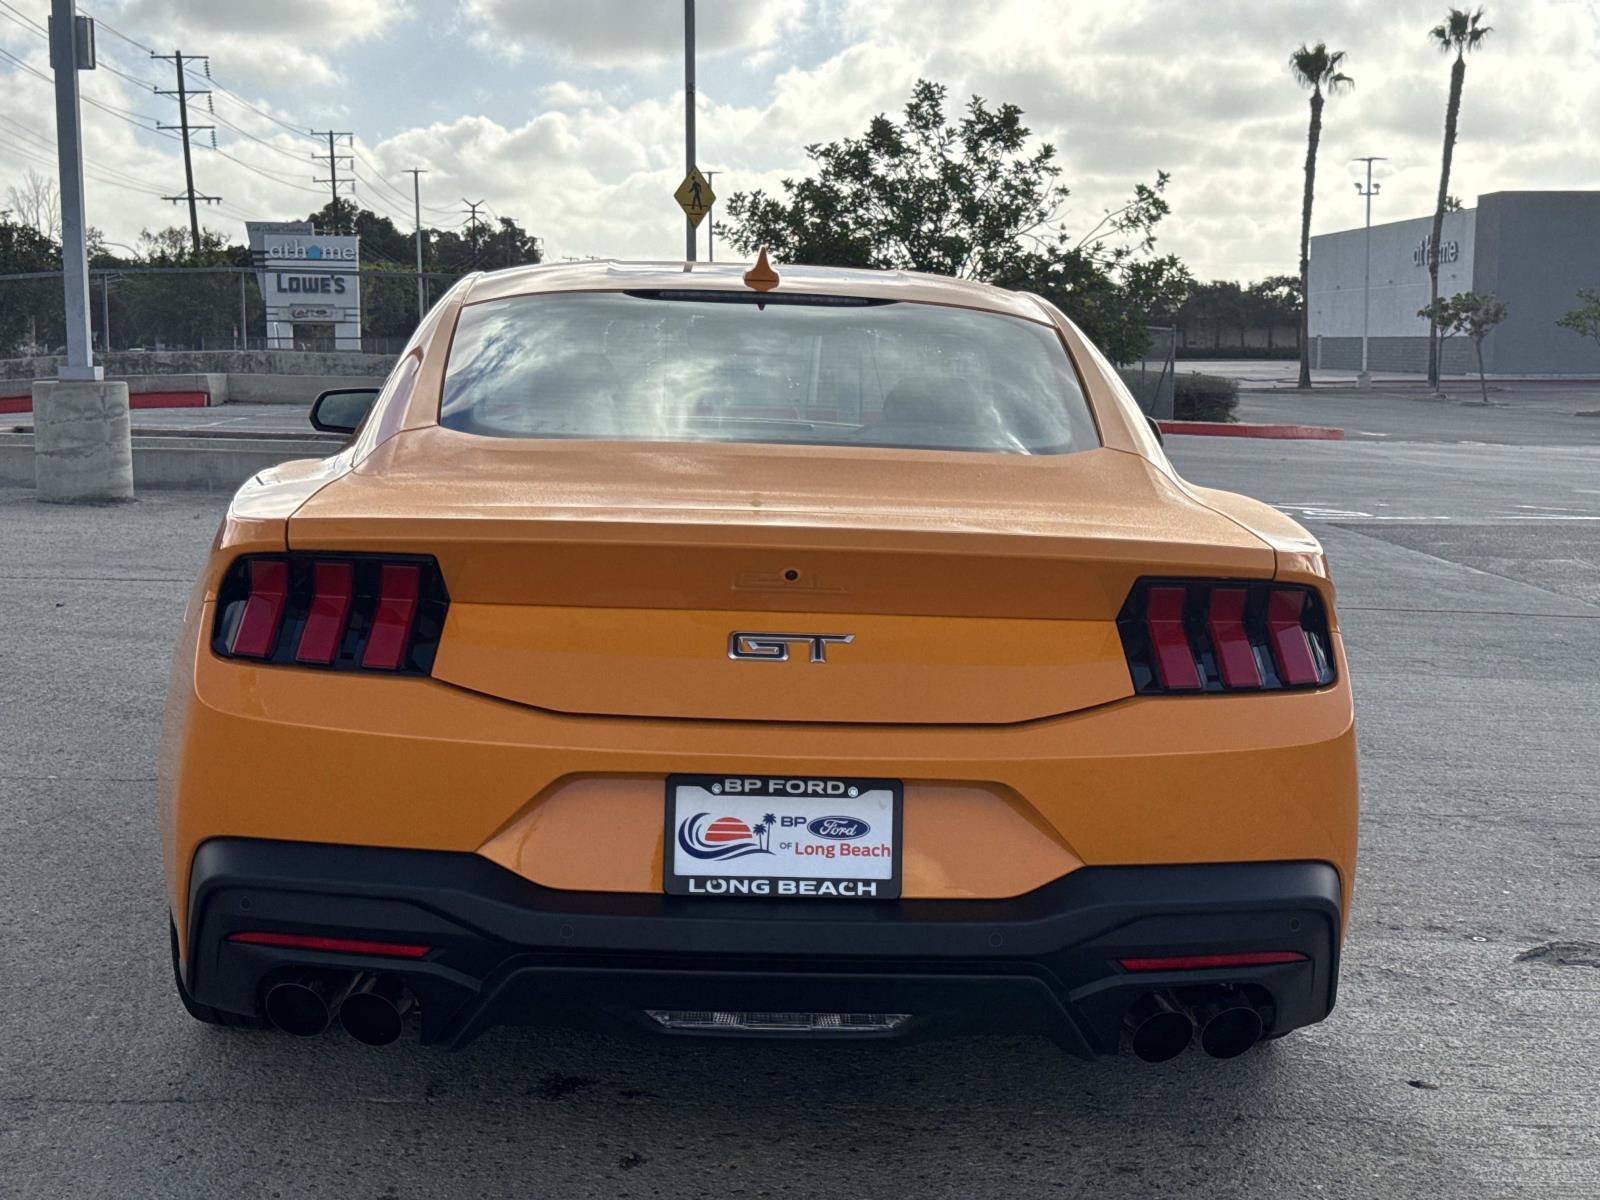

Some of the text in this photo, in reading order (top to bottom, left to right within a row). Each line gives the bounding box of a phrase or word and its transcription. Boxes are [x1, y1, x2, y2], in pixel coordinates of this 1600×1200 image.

[276, 272, 346, 294] LOWE'S
[728, 631, 855, 663] GT
[724, 778, 845, 795] BP FORD
[780, 816, 857, 836] BP Ford
[779, 842, 891, 858] OF Long Beach
[689, 878, 877, 897] LONG BEACH
